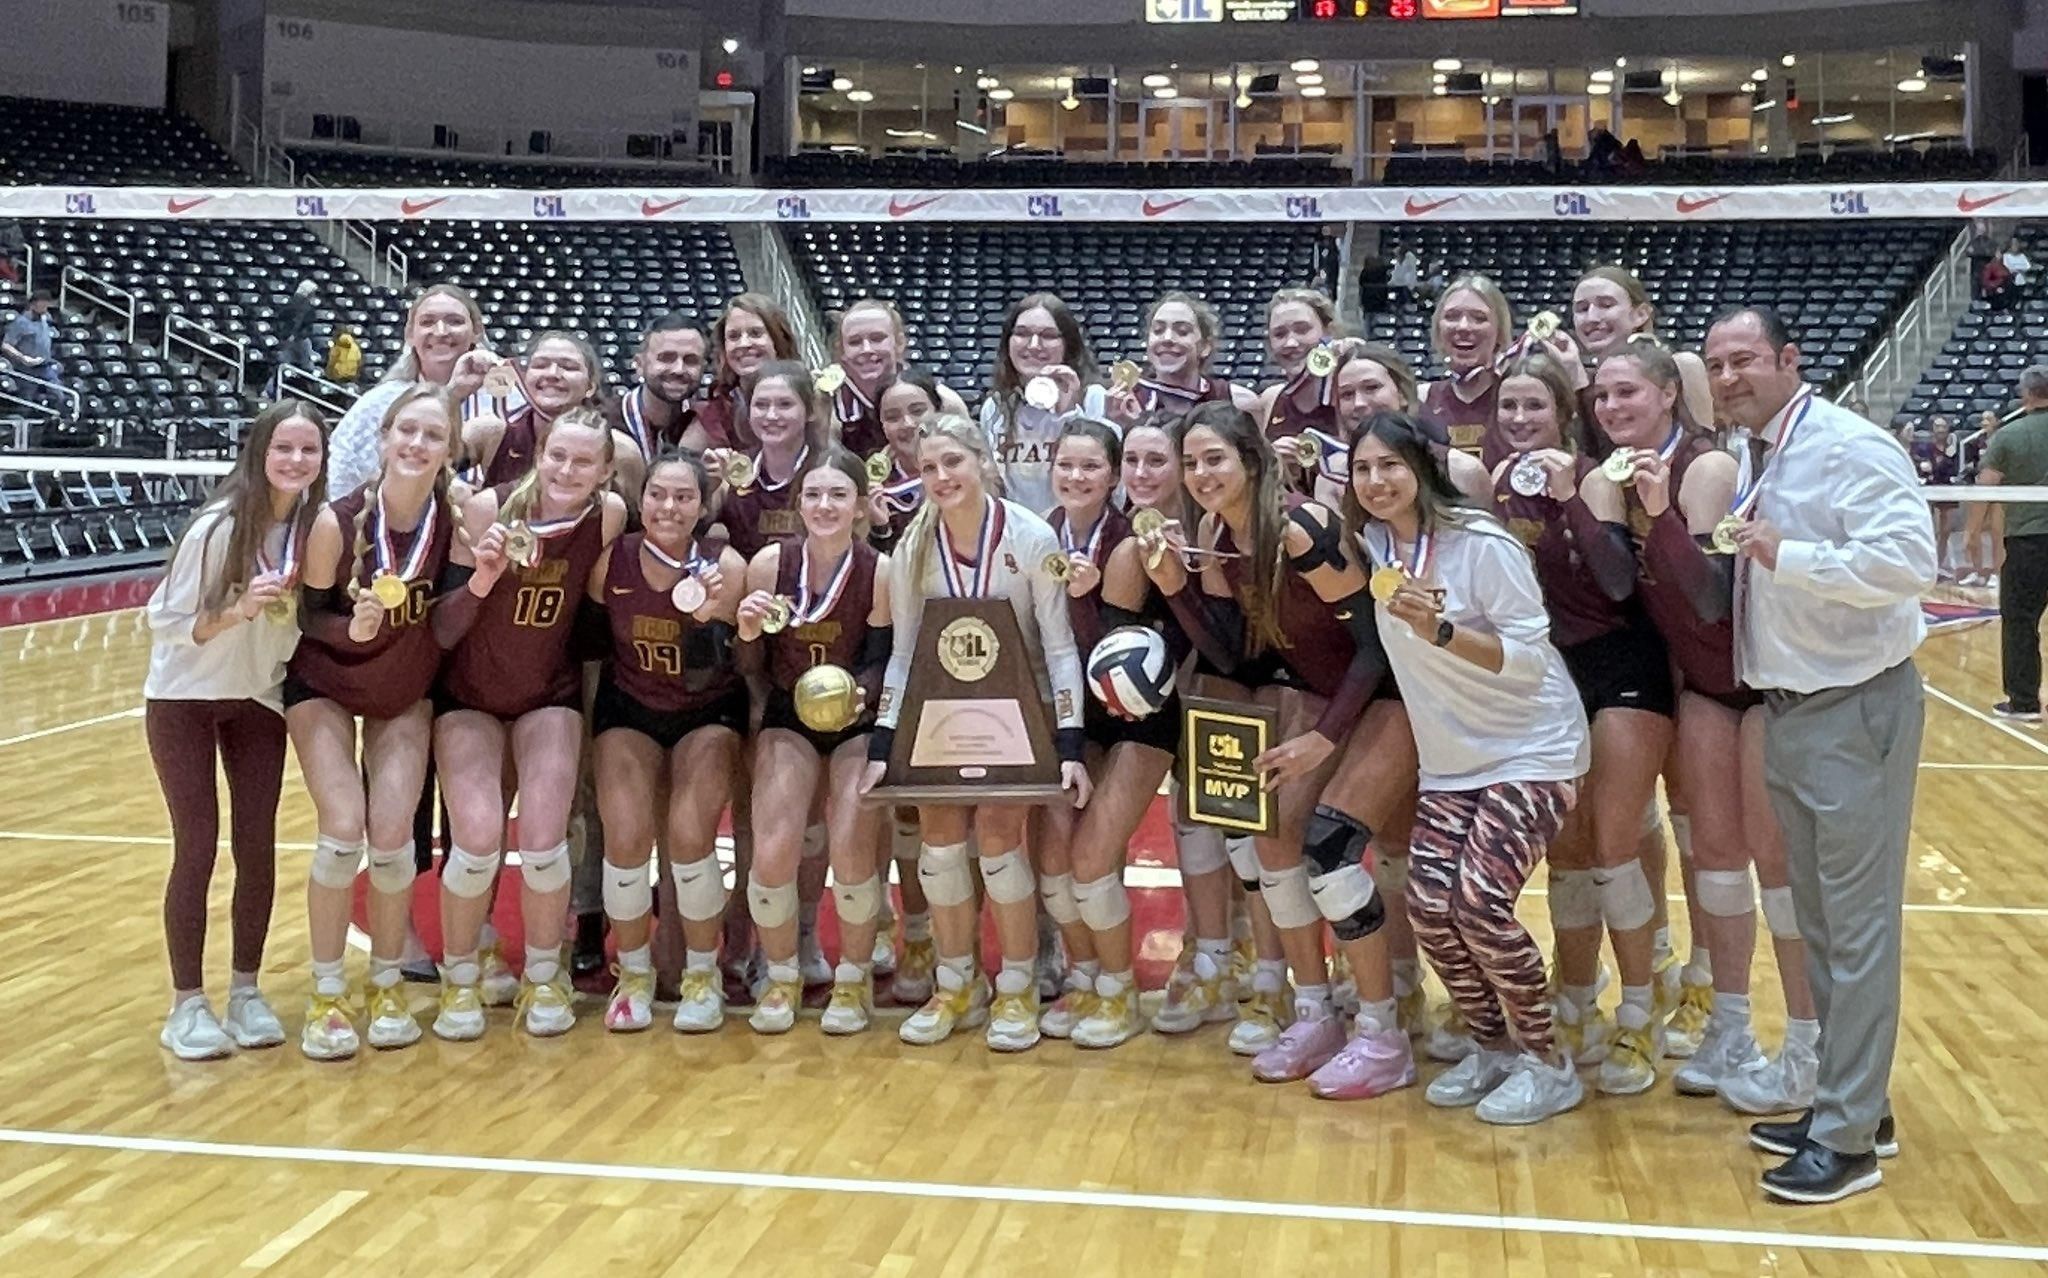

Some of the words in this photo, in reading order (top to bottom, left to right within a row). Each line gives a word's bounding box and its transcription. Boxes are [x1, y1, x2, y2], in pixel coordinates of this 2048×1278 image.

[117, 4, 155, 23] 105
[277, 22, 314, 40] 106
[656, 51, 689, 69] 106
[513, 587, 565, 627] 18
[633, 640, 680, 674] 19
[1205, 779, 1250, 799] MVP
